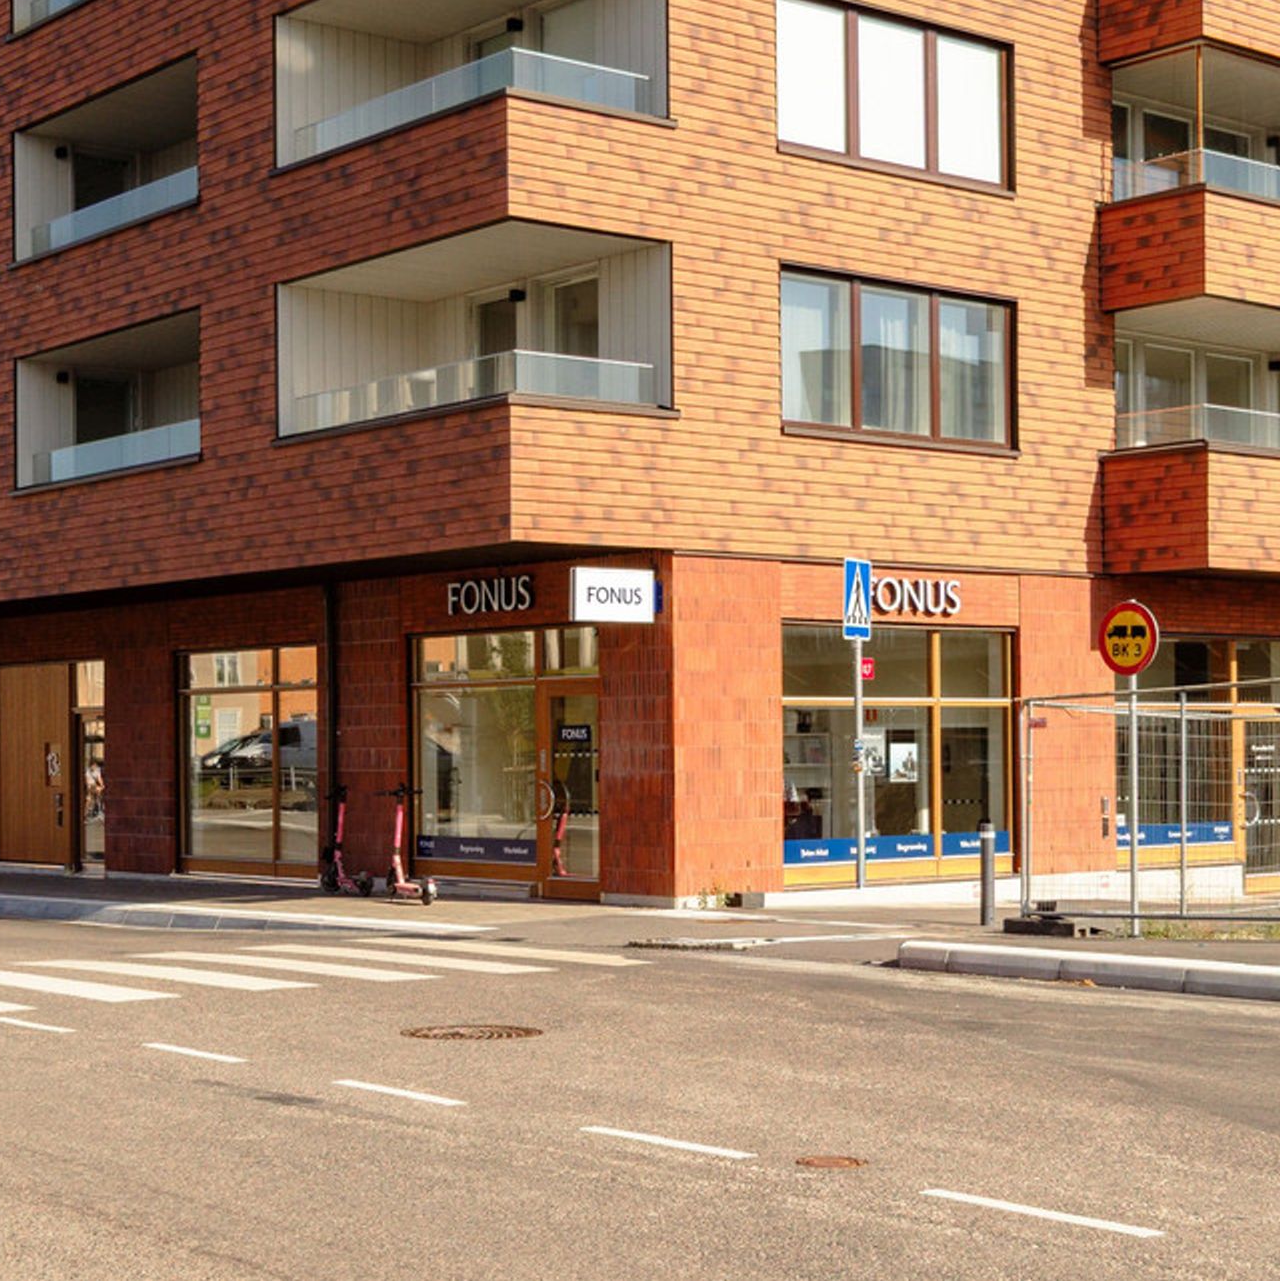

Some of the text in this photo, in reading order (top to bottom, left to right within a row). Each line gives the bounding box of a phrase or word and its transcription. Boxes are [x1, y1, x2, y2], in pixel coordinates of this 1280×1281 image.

[447, 575, 532, 616] FONUS
[586, 586, 643, 606] FONUS
[1112, 643, 1142, 657] BK 3
[561, 727, 588, 740] FONUS
